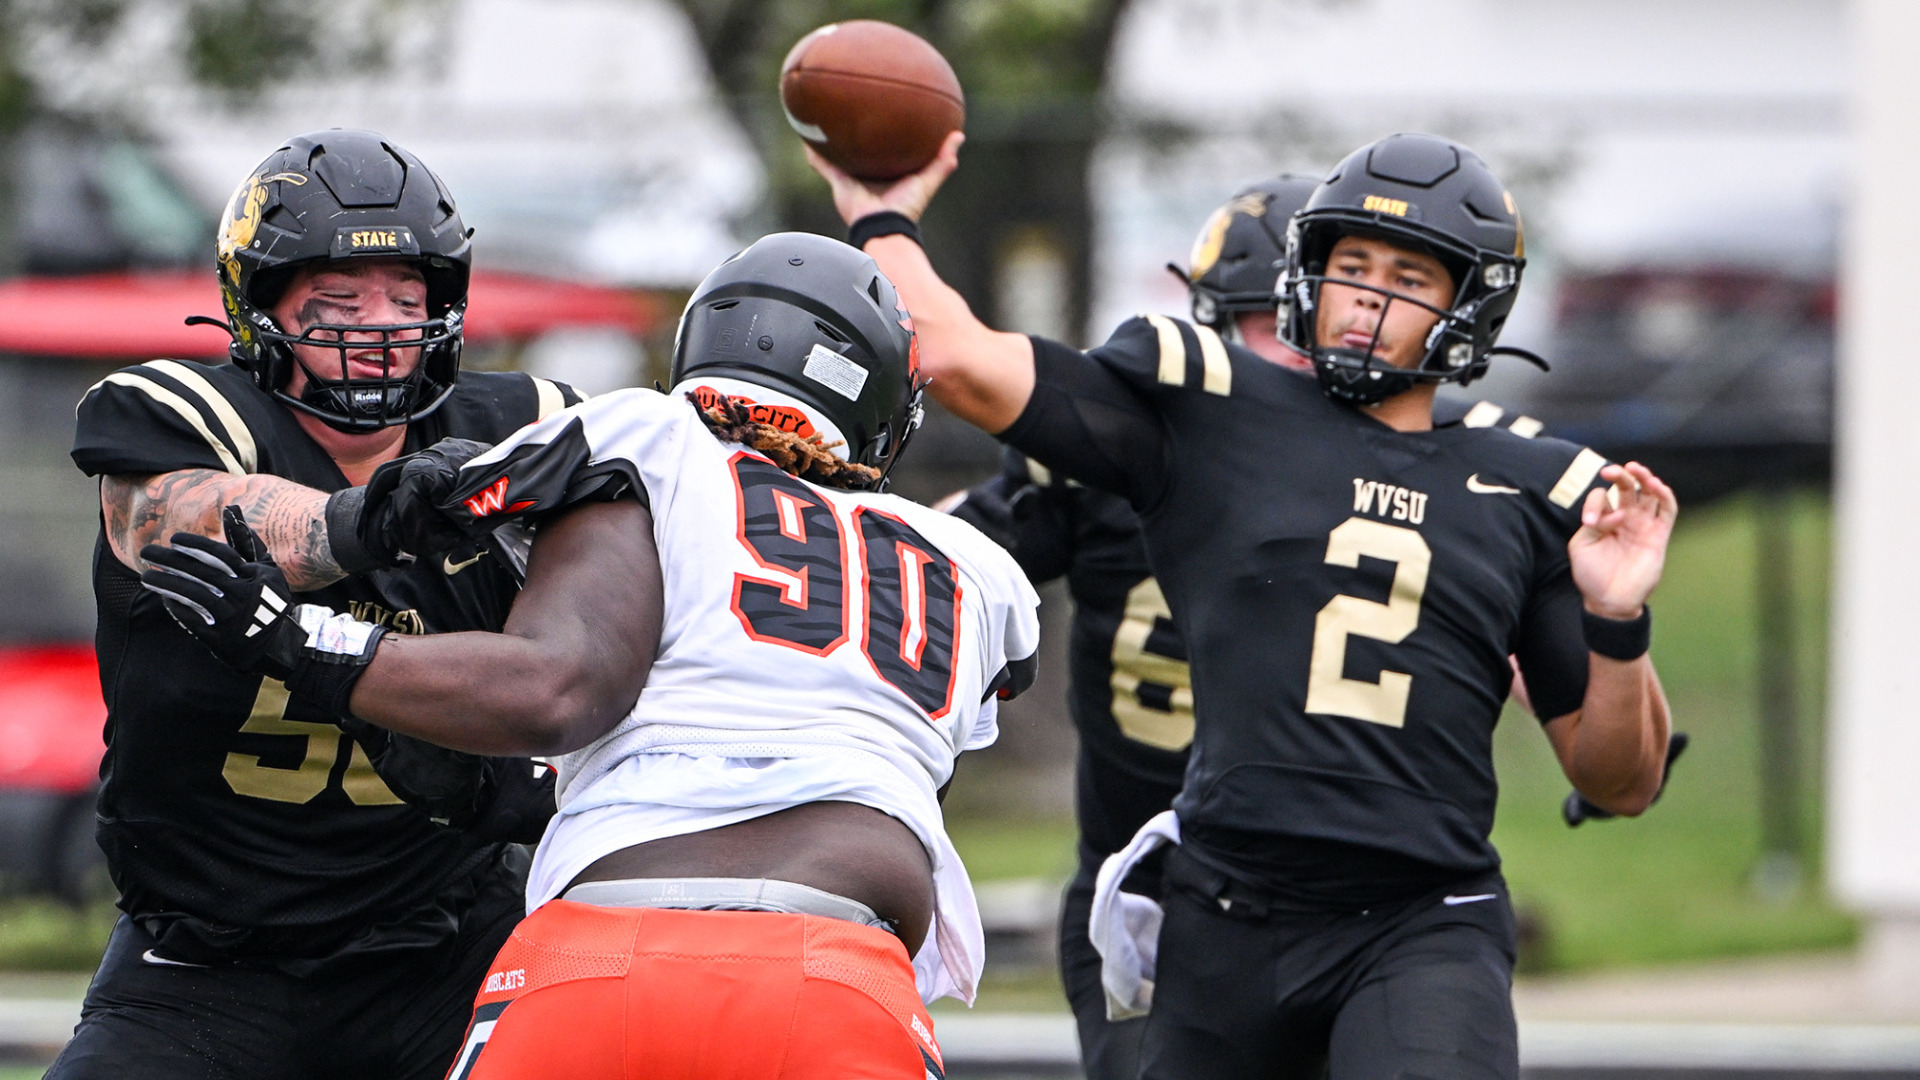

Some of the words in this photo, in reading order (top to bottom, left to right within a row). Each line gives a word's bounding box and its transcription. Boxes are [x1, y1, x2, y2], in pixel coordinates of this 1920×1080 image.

[1363, 195, 1408, 216] STATE
[351, 231, 397, 247] STATE
[355, 392, 382, 401] Ridde
[753, 405, 807, 433] CITY
[463, 476, 509, 517] W
[1352, 478, 1428, 524] WVSU
[727, 450, 963, 721] 90
[1304, 516, 1432, 728] 2
[1110, 576, 1196, 751] 6
[222, 675, 407, 806] 5
